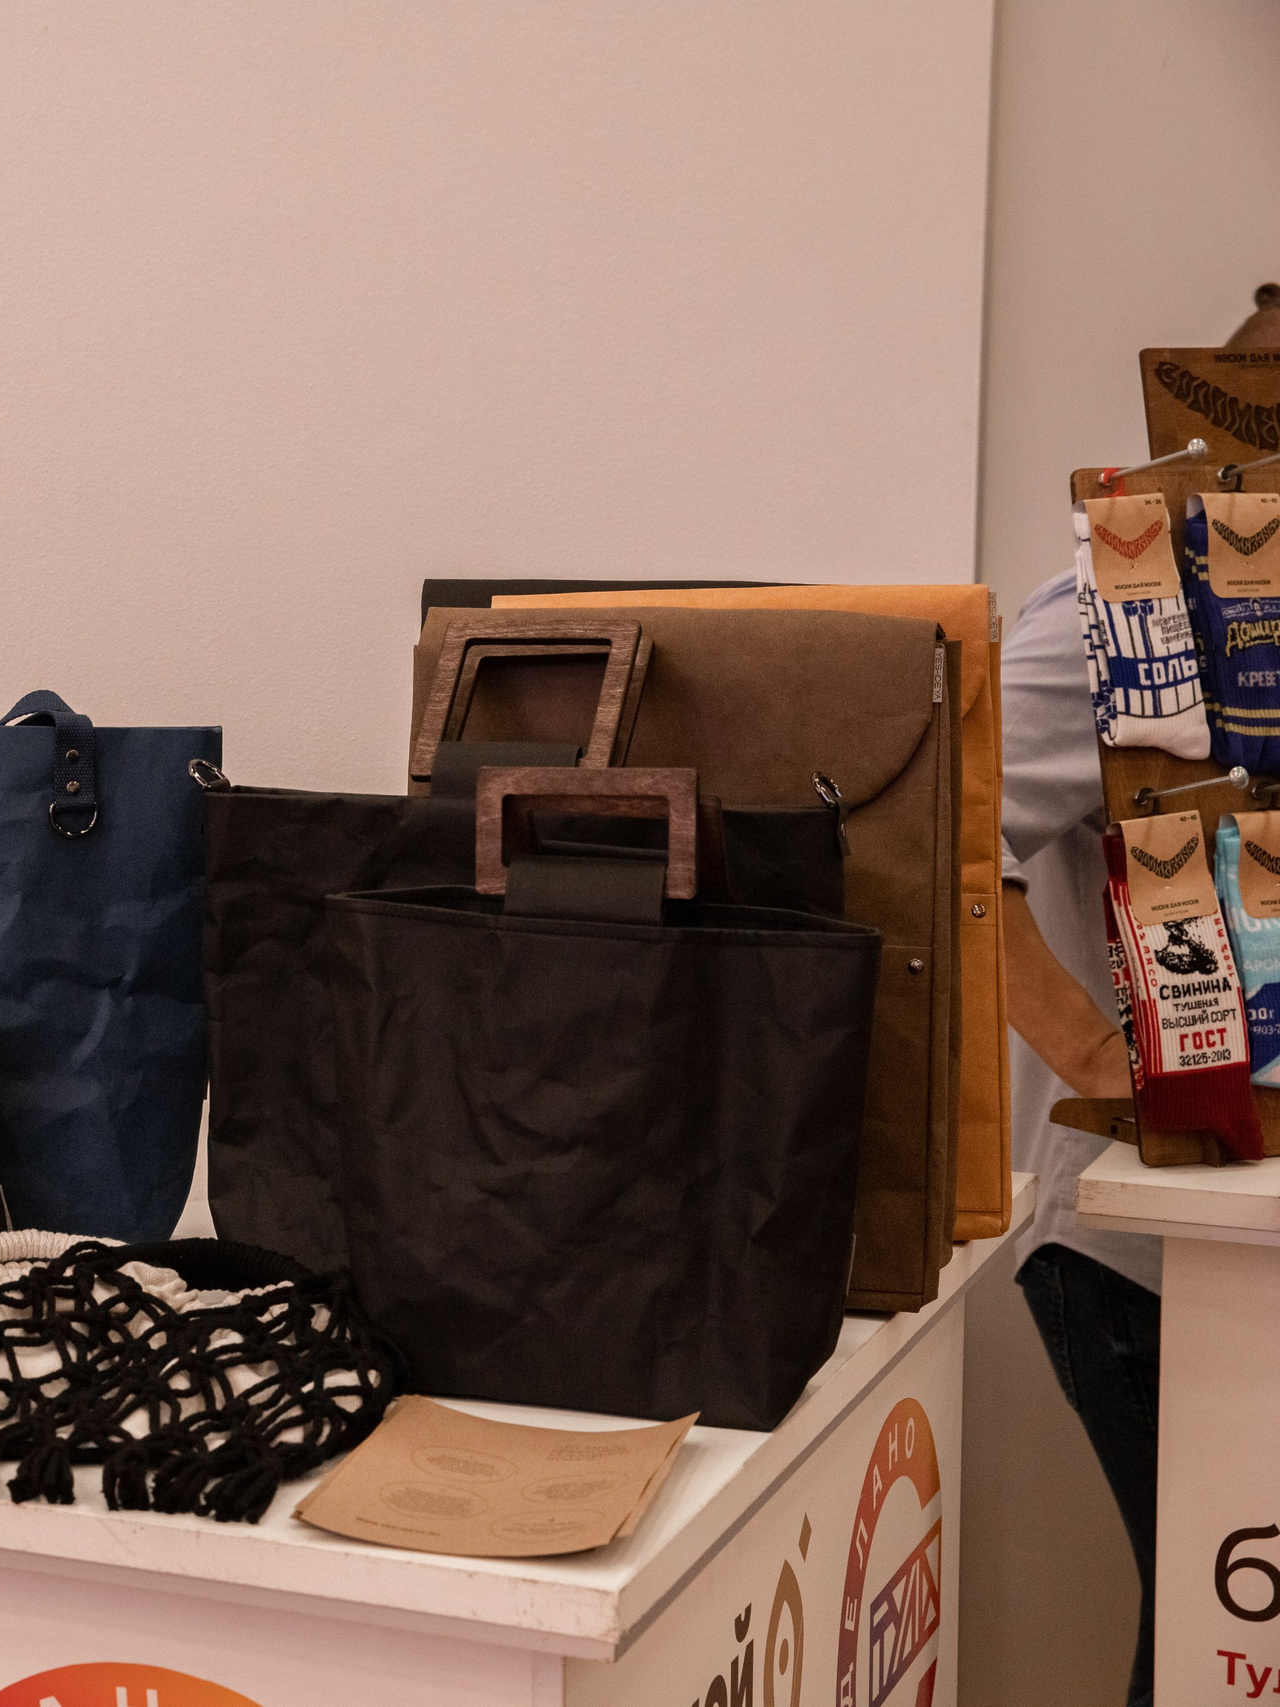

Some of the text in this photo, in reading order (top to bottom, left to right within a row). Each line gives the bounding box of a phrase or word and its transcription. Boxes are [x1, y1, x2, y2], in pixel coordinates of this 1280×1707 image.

[1138, 655, 1198, 686] СОЛЬ
[1159, 976, 1233, 1000] СВИНИНА
[1173, 997, 1219, 1013] ТУШЕНАЯ
[1161, 1008, 1238, 1030] ВЫСШИЙ СОРТ
[1179, 1027, 1227, 1052] ГОСТ
[1217, 1649, 1280, 1699] Ту
